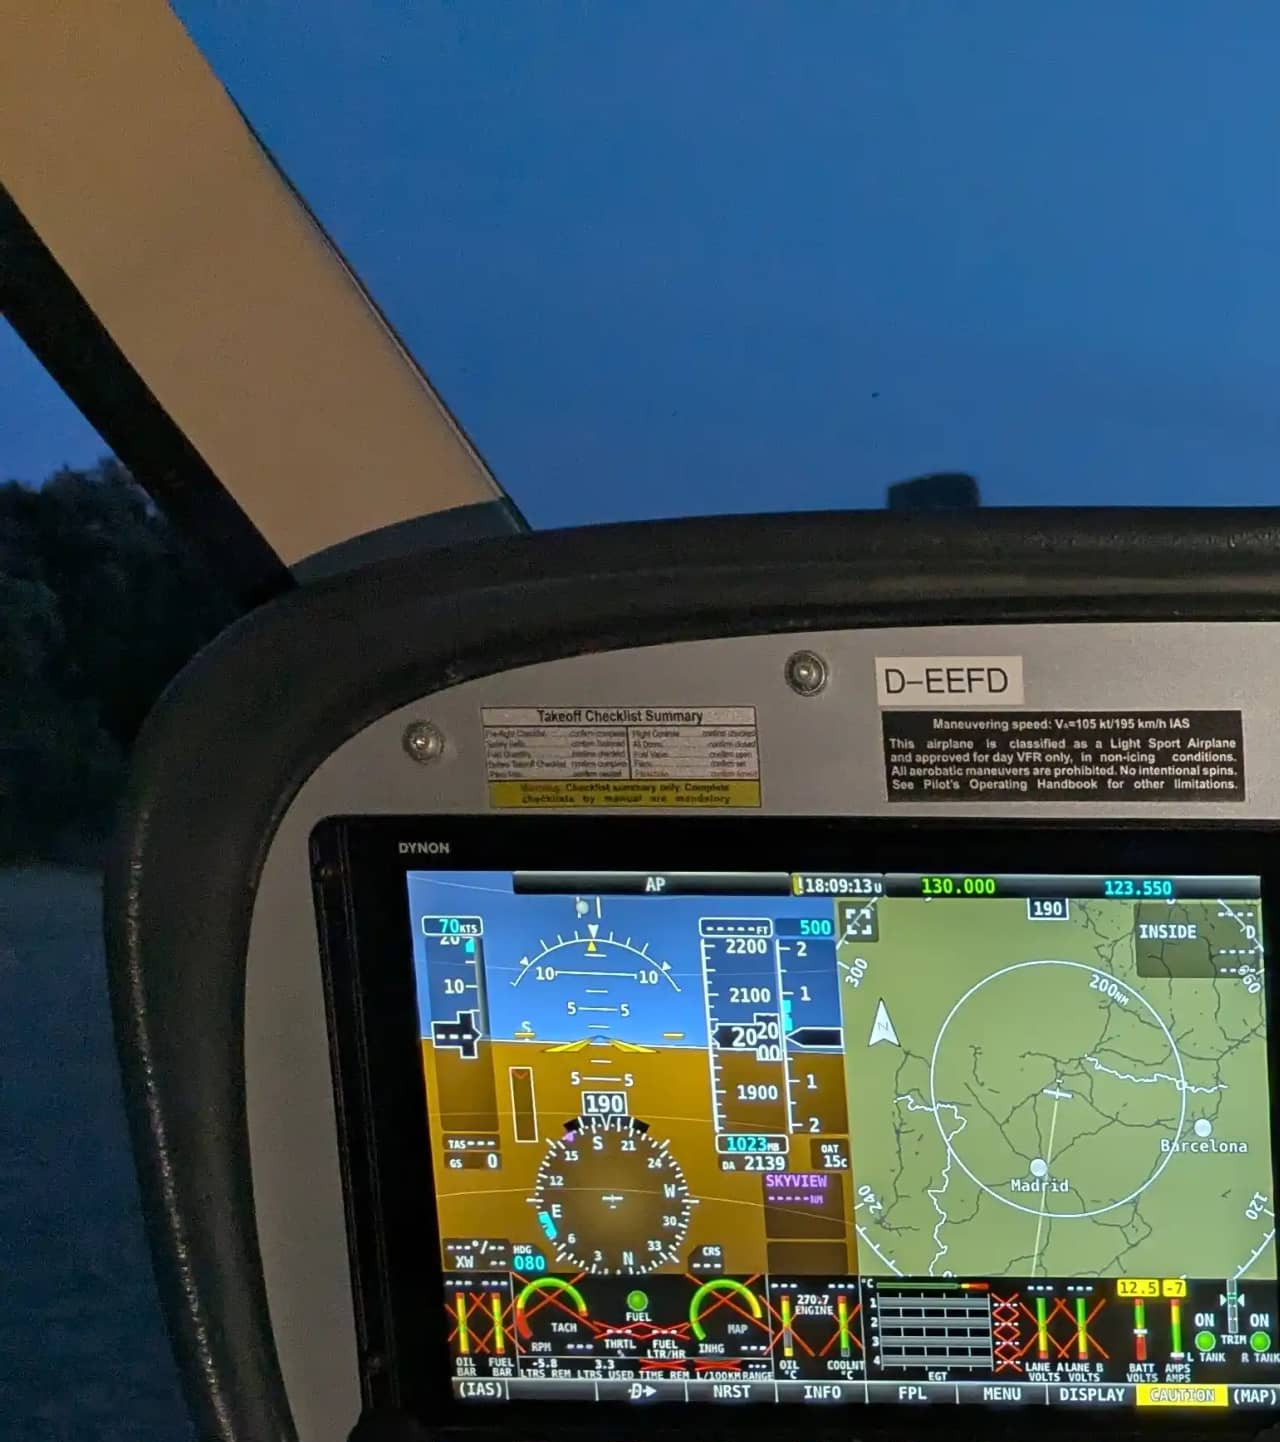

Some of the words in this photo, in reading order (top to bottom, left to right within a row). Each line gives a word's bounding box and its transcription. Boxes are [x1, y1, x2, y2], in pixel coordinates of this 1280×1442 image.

[884, 667, 1008, 694] D-EEFD
[538, 710, 584, 722] Takeoff
[586, 709, 643, 722] Checklist
[646, 710, 703, 724] Summary
[933, 718, 1009, 731] Maneuvering
[1012, 718, 1052, 731] speed:
[1100, 718, 1135, 730] kt/195
[1138, 718, 1166, 730] km/h
[1169, 718, 1190, 729] IAS
[889, 738, 915, 749] This
[926, 739, 974, 752] airplane
[986, 739, 997, 749] is
[1009, 738, 1066, 749] classified
[1074, 740, 1088, 749] as
[1096, 740, 1102, 749] a
[1110, 738, 1141, 752] Light
[1149, 739, 1181, 752] Sport
[1187, 738, 1236, 752] Airplane
[890, 752, 912, 763] and
[915, 752, 970, 765] approved
[973, 752, 990, 763] for
[992, 752, 1014, 765] day
[1017, 752, 1042, 762] VFR
[1045, 751, 1074, 765] only,
[1081, 752, 1092, 762] in
[1100, 752, 1156, 765] non-icing
[1172, 751, 1237, 763] conditions.
[891, 766, 907, 776] All
[909, 765, 963, 777] aerobatic
[966, 767, 1030, 777] maneuvers
[1032, 767, 1052, 777] are
[1054, 765, 1117, 778] prohibited.
[1119, 766, 1136, 776] No
[1138, 765, 1200, 776] intentional
[1202, 765, 1238, 778] spins.
[892, 780, 915, 790] See
[923, 779, 960, 790] Pilot's
[969, 779, 1027, 792] Operating
[1037, 779, 1097, 790] Handbook
[1107, 779, 1124, 790] for
[1134, 779, 1165, 790] other
[1174, 778, 1238, 790] limitations.
[399, 843, 450, 854] DYNON
[922, 878, 995, 894] 130.000
[1105, 881, 1172, 896] 123.550
[1139, 924, 1196, 939] INSIDE
[1160, 1139, 1247, 1153] Barcelona
[1010, 1178, 1069, 1193] Madrid
[1060, 1387, 1125, 1402] DISPLAY
